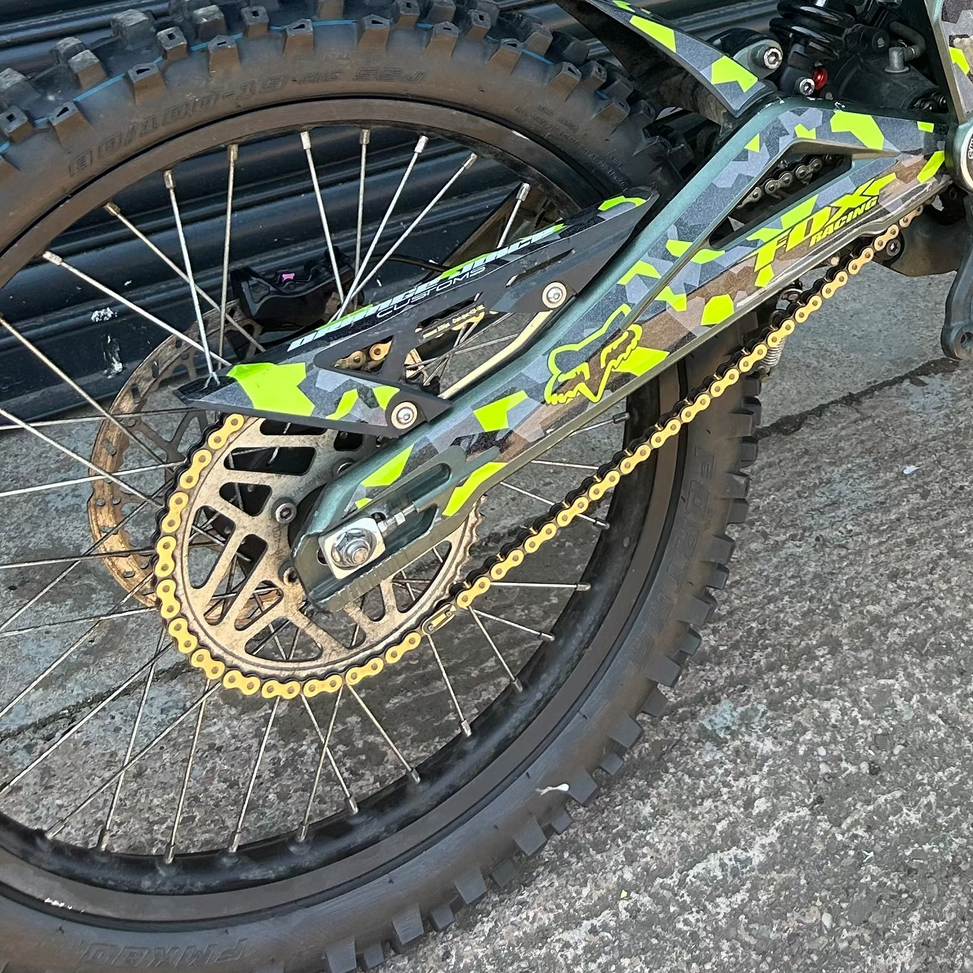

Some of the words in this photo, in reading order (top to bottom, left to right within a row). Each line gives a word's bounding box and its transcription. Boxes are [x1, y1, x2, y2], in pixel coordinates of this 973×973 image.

[740, 172, 897, 273] FOX
[809, 196, 879, 248] RACING
[377, 264, 486, 320] CUSTOMS
